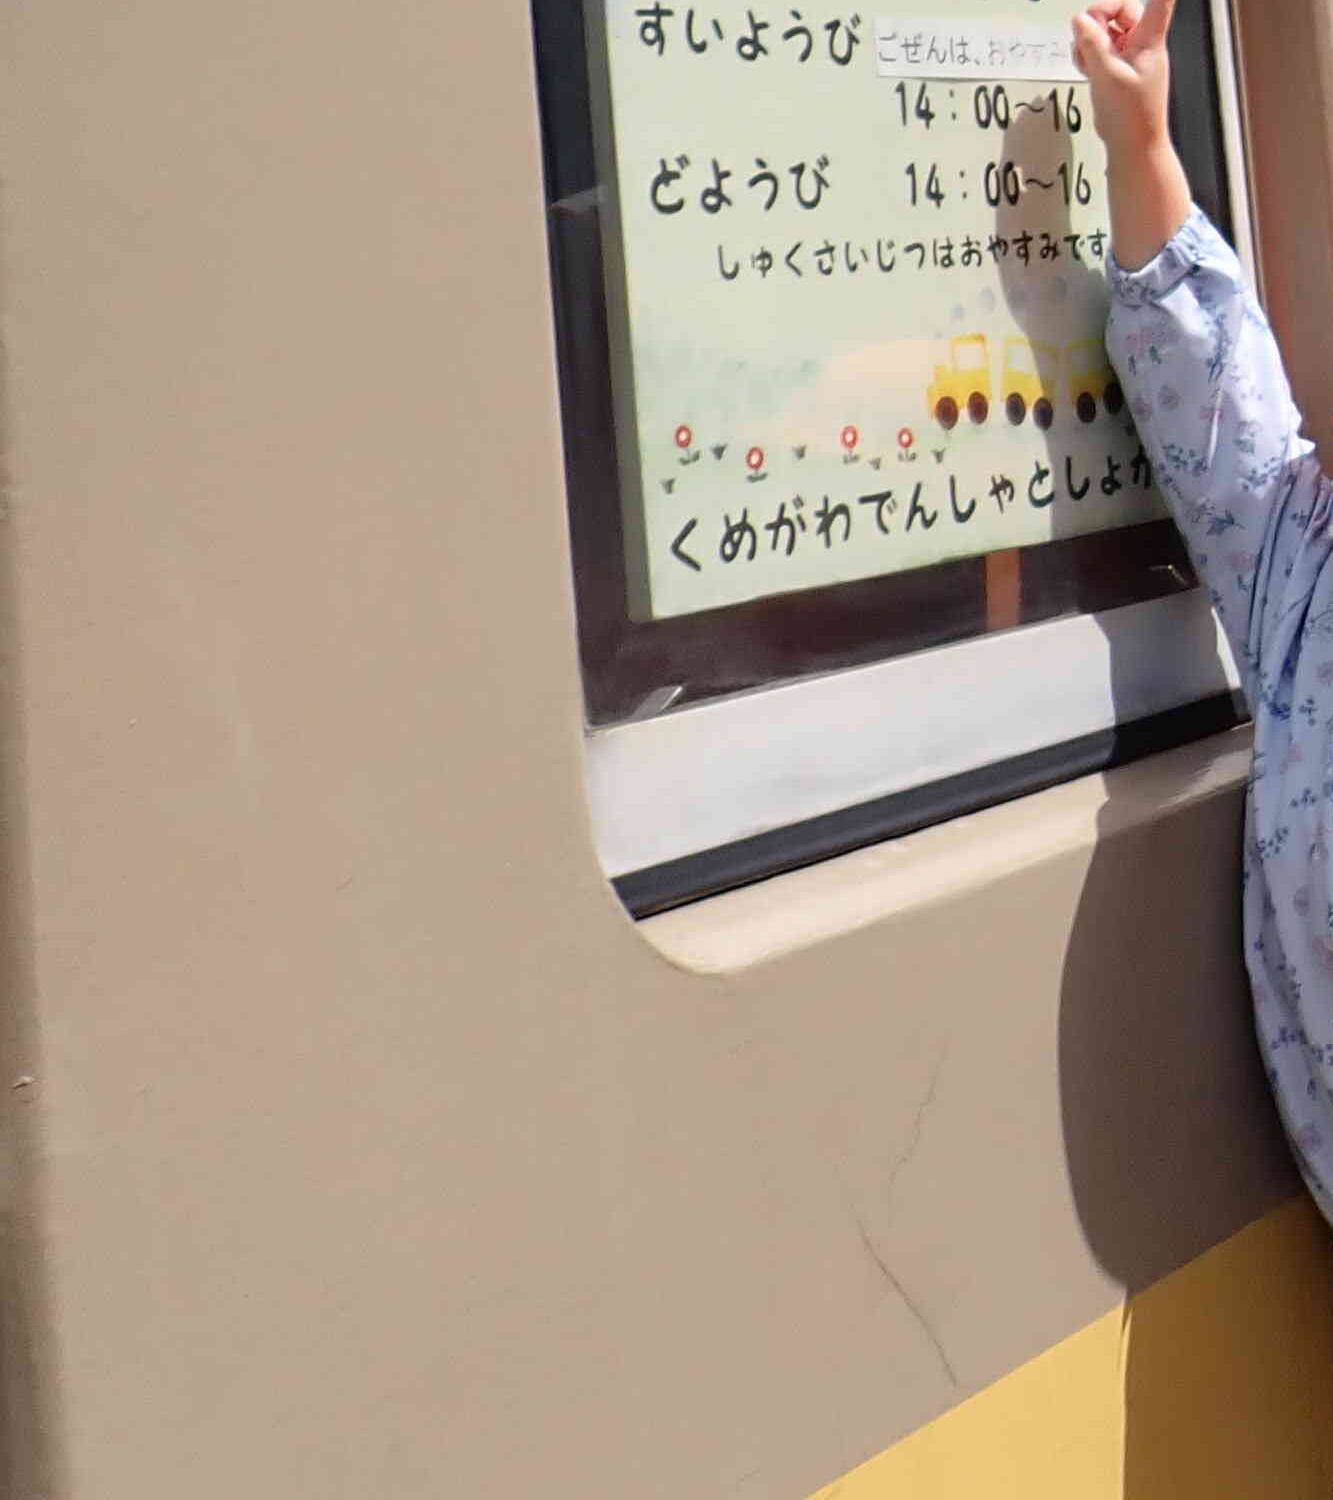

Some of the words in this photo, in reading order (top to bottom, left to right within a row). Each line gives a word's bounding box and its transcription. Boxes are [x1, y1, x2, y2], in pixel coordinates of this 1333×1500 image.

[635, 1, 861, 65] すいようび
[650, 153, 830, 215] どようび
[719, 228, 1107, 280] しゅくさいじつはおやすみです
